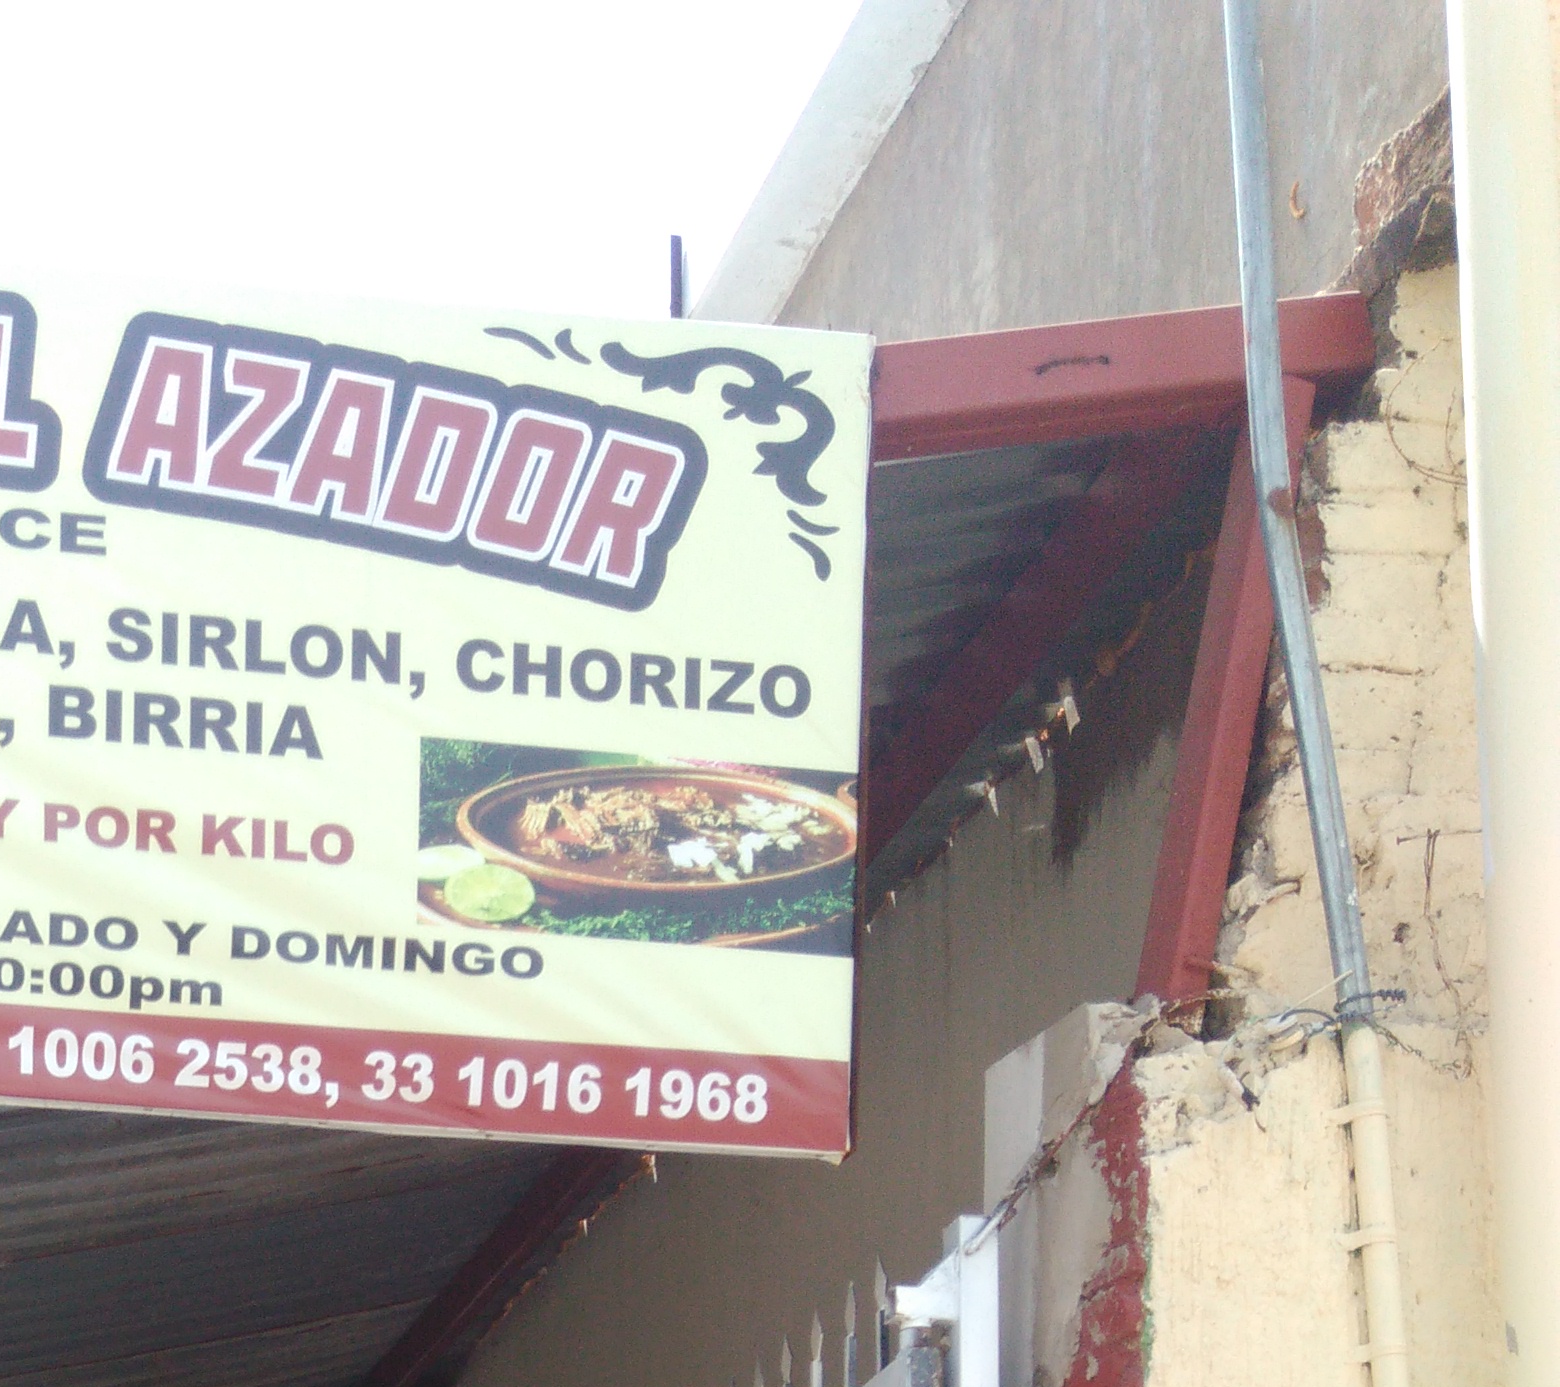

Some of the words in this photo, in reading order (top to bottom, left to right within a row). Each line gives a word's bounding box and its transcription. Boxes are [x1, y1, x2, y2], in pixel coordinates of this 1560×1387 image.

[95, 323, 696, 600] AZADOR
[106, 608, 426, 698] SIRLON,
[456, 638, 811, 720] CHORIZO
[48, 685, 323, 759] BIRRIA
[44, 803, 177, 854] POR
[201, 815, 354, 865] KILO
[162, 921, 208, 956] Y
[232, 925, 544, 980] DOMINGO
[7, 1026, 154, 1085] 1006
[175, 1038, 338, 1106] 2538,
[362, 1049, 434, 1102] 33
[457, 1056, 601, 1113] 1016
[623, 1067, 769, 1124] 1968
